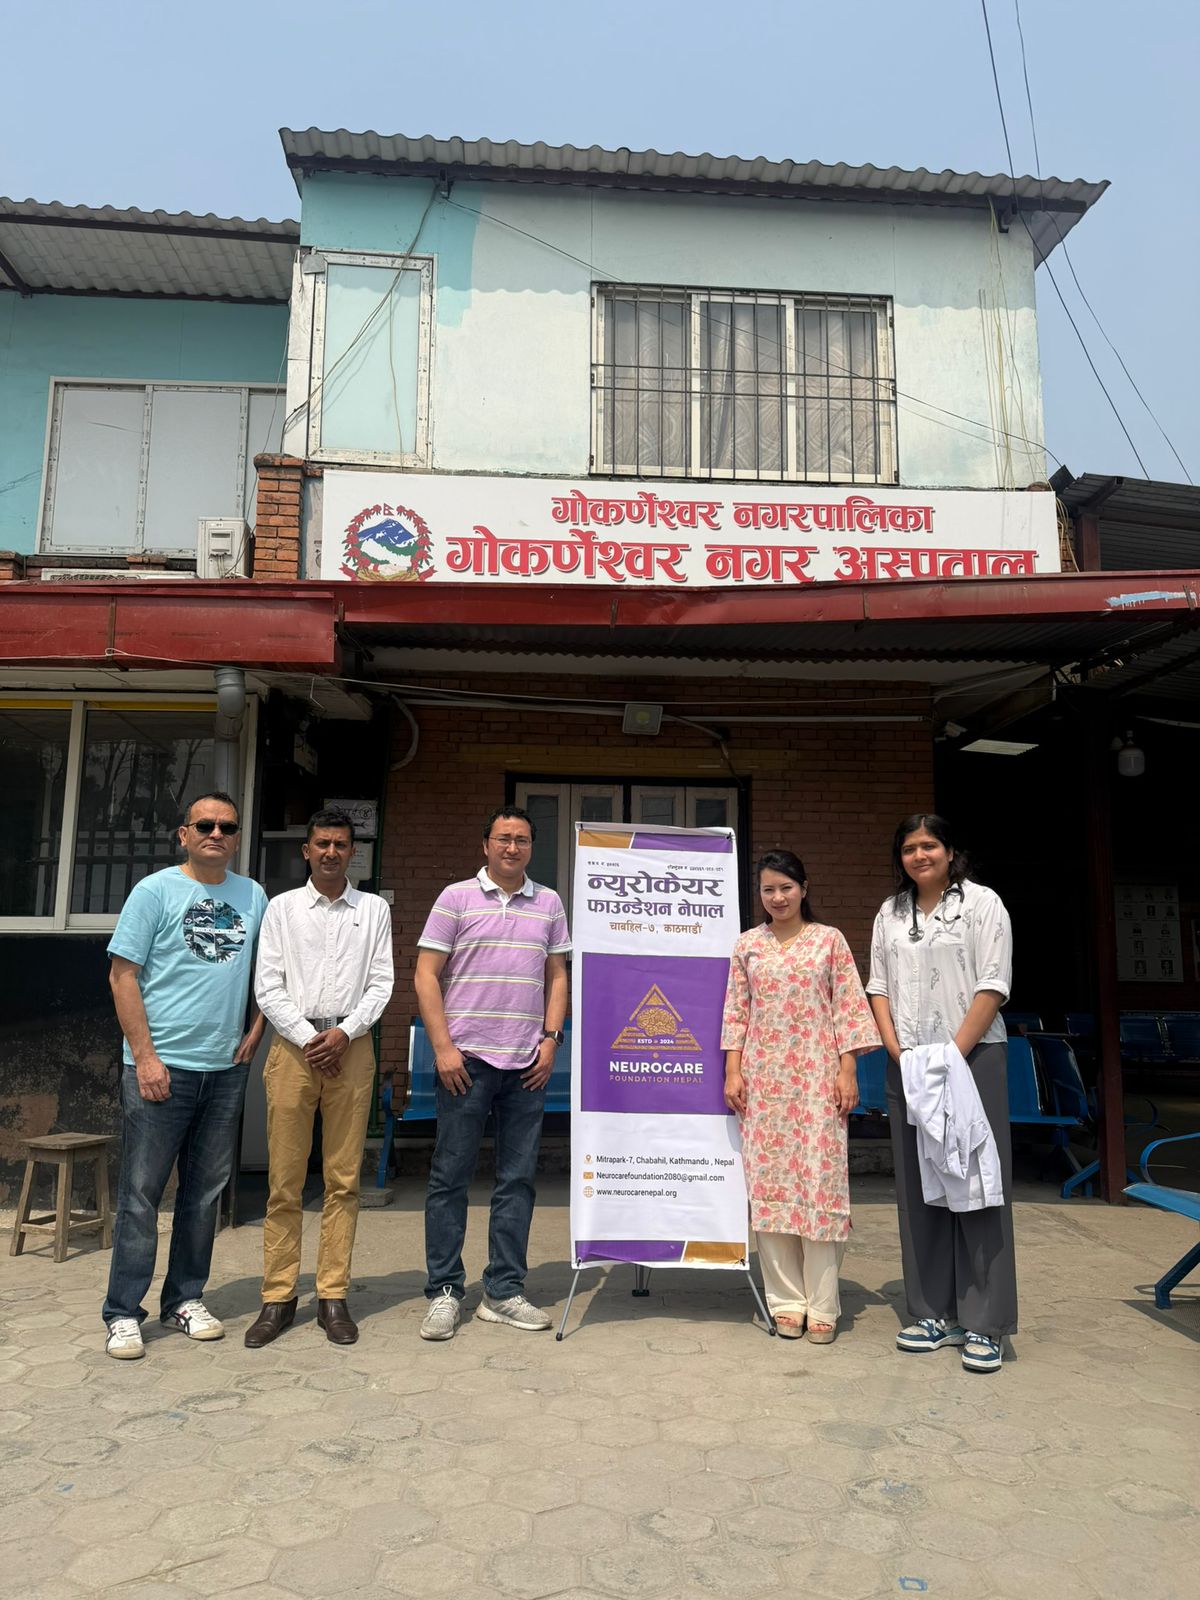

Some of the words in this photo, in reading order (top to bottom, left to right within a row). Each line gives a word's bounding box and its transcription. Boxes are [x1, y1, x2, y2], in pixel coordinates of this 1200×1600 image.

[551, 489, 724, 529] गोकर्णेश्वर
[732, 495, 935, 532] नगरपालिका
[445, 525, 691, 581] गोकर्णेश्वर
[704, 543, 819, 583] नगर
[587, 870, 724, 897] न्युरोकेयर
[587, 897, 673, 916] फाउन्डेशन
[677, 899, 725, 918] नेपाल
[609, 1060, 704, 1074] NEUROCARE
[609, 1074, 670, 1083] FOUNDATION
[673, 1076, 704, 1084] NEPAL
[596, 1155, 635, 1165] Mitrapark-7,
[635, 1156, 669, 1165] Chabahil,
[669, 1157, 709, 1166] Kathmandu
[714, 1158, 735, 1167] Nepal
[596, 1171, 725, 1183] Neurocarefoundation2080@gmail.com
[596, 1188, 678, 1198] www.neurocarenepal.org
